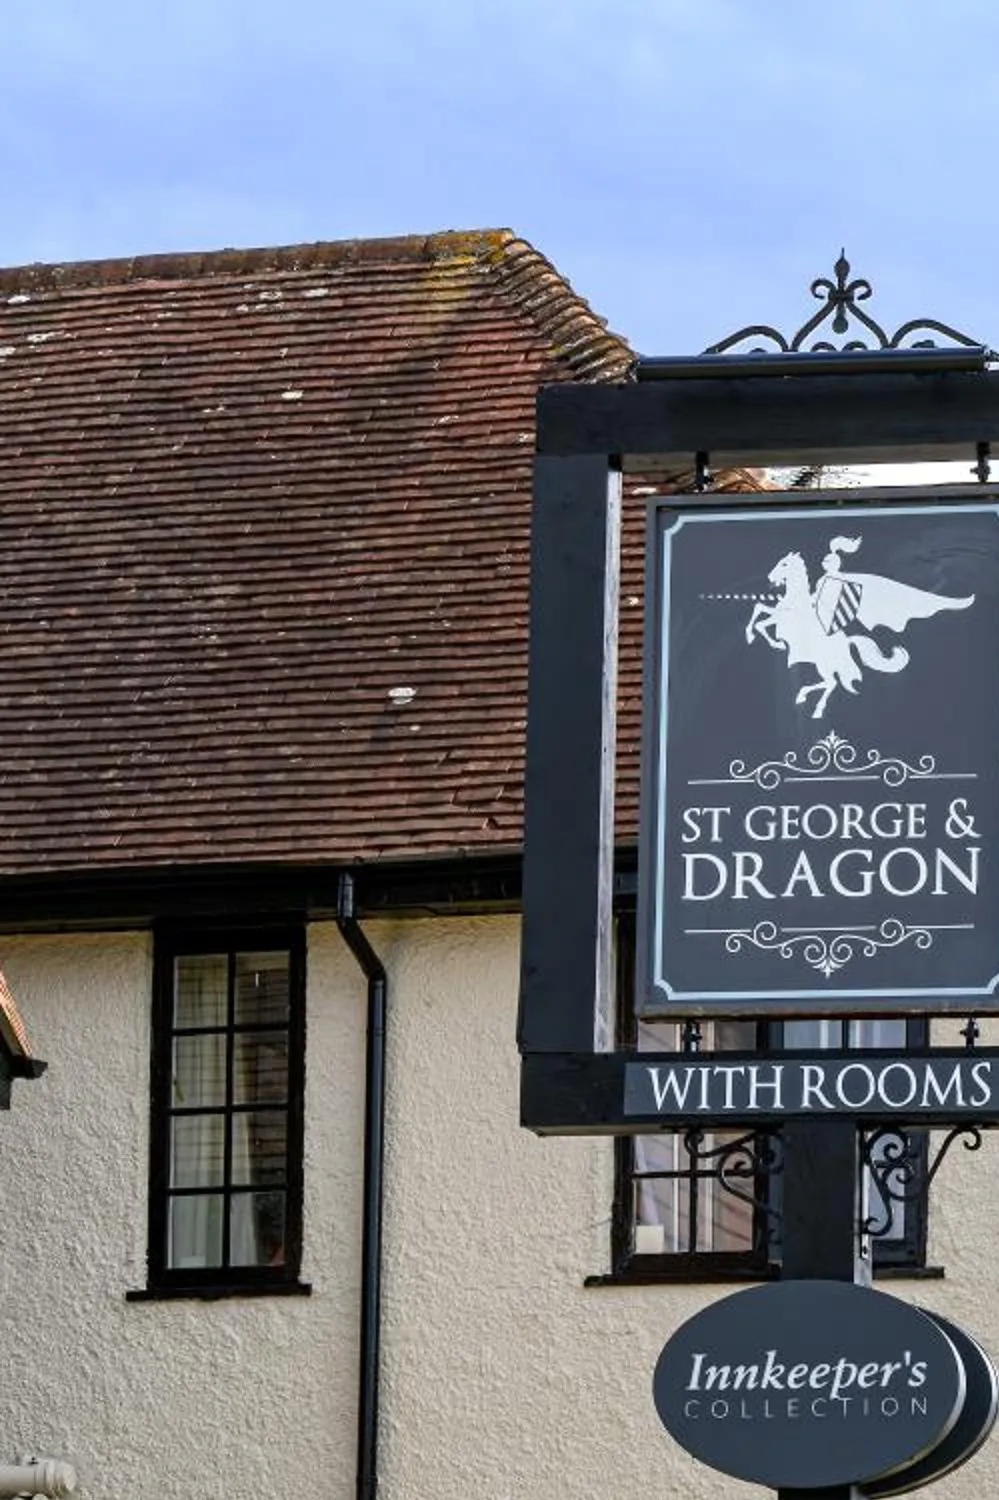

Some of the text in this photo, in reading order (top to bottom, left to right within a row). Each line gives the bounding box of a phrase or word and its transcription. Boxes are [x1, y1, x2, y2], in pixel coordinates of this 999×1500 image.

[681, 798, 982, 843] ST GEORGE &
[681, 846, 982, 901] DRAGON
[647, 1060, 993, 1112] WITH ROOMS
[685, 1350, 929, 1400] Innkeeper's
[684, 1397, 928, 1419] COLLECTION
